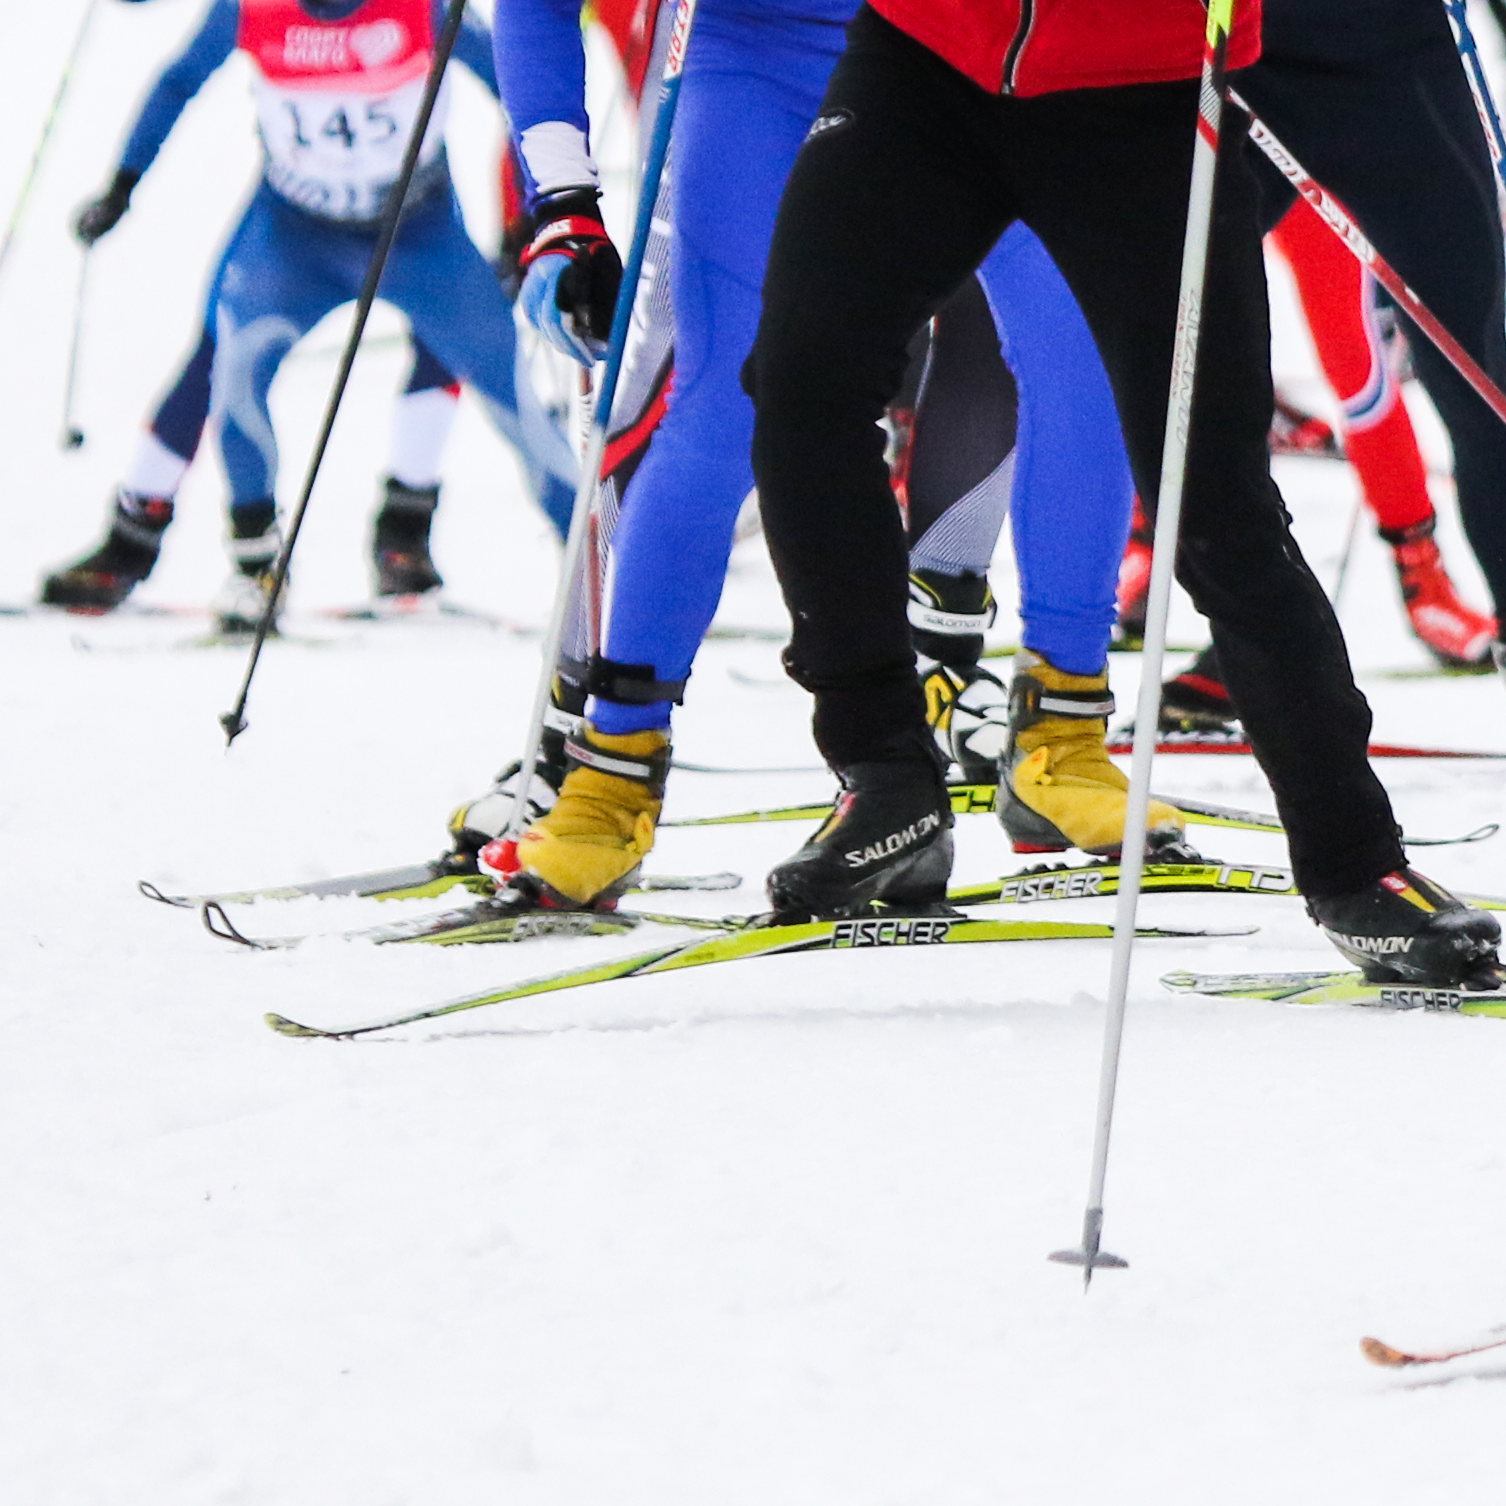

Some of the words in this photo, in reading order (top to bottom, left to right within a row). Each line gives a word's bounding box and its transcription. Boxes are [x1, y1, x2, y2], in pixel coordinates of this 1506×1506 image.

[284, 98, 398, 150] 145
[845, 809, 942, 868] SALOMON
[1000, 871, 1104, 904] FISCHER
[830, 920, 951, 948] FISCHER
[1380, 989, 1464, 1013] FISCHER
